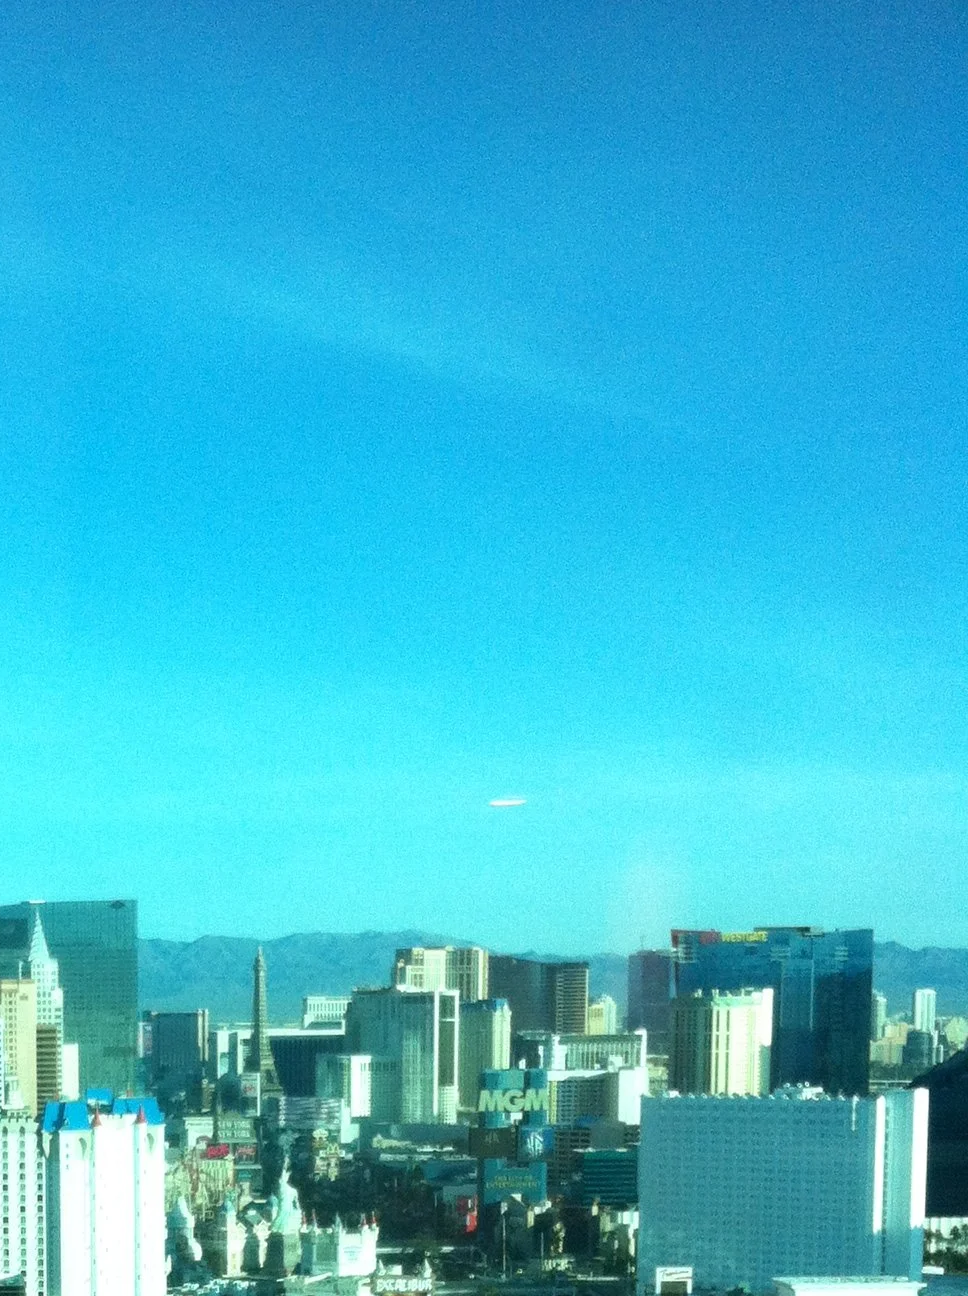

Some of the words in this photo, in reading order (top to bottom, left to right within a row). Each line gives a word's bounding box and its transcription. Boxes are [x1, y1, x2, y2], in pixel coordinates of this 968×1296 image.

[721, 931, 768, 944] WESTGATE
[478, 1089, 549, 1112] MGM
[376, 1279, 432, 1292] EXCALIBUR
